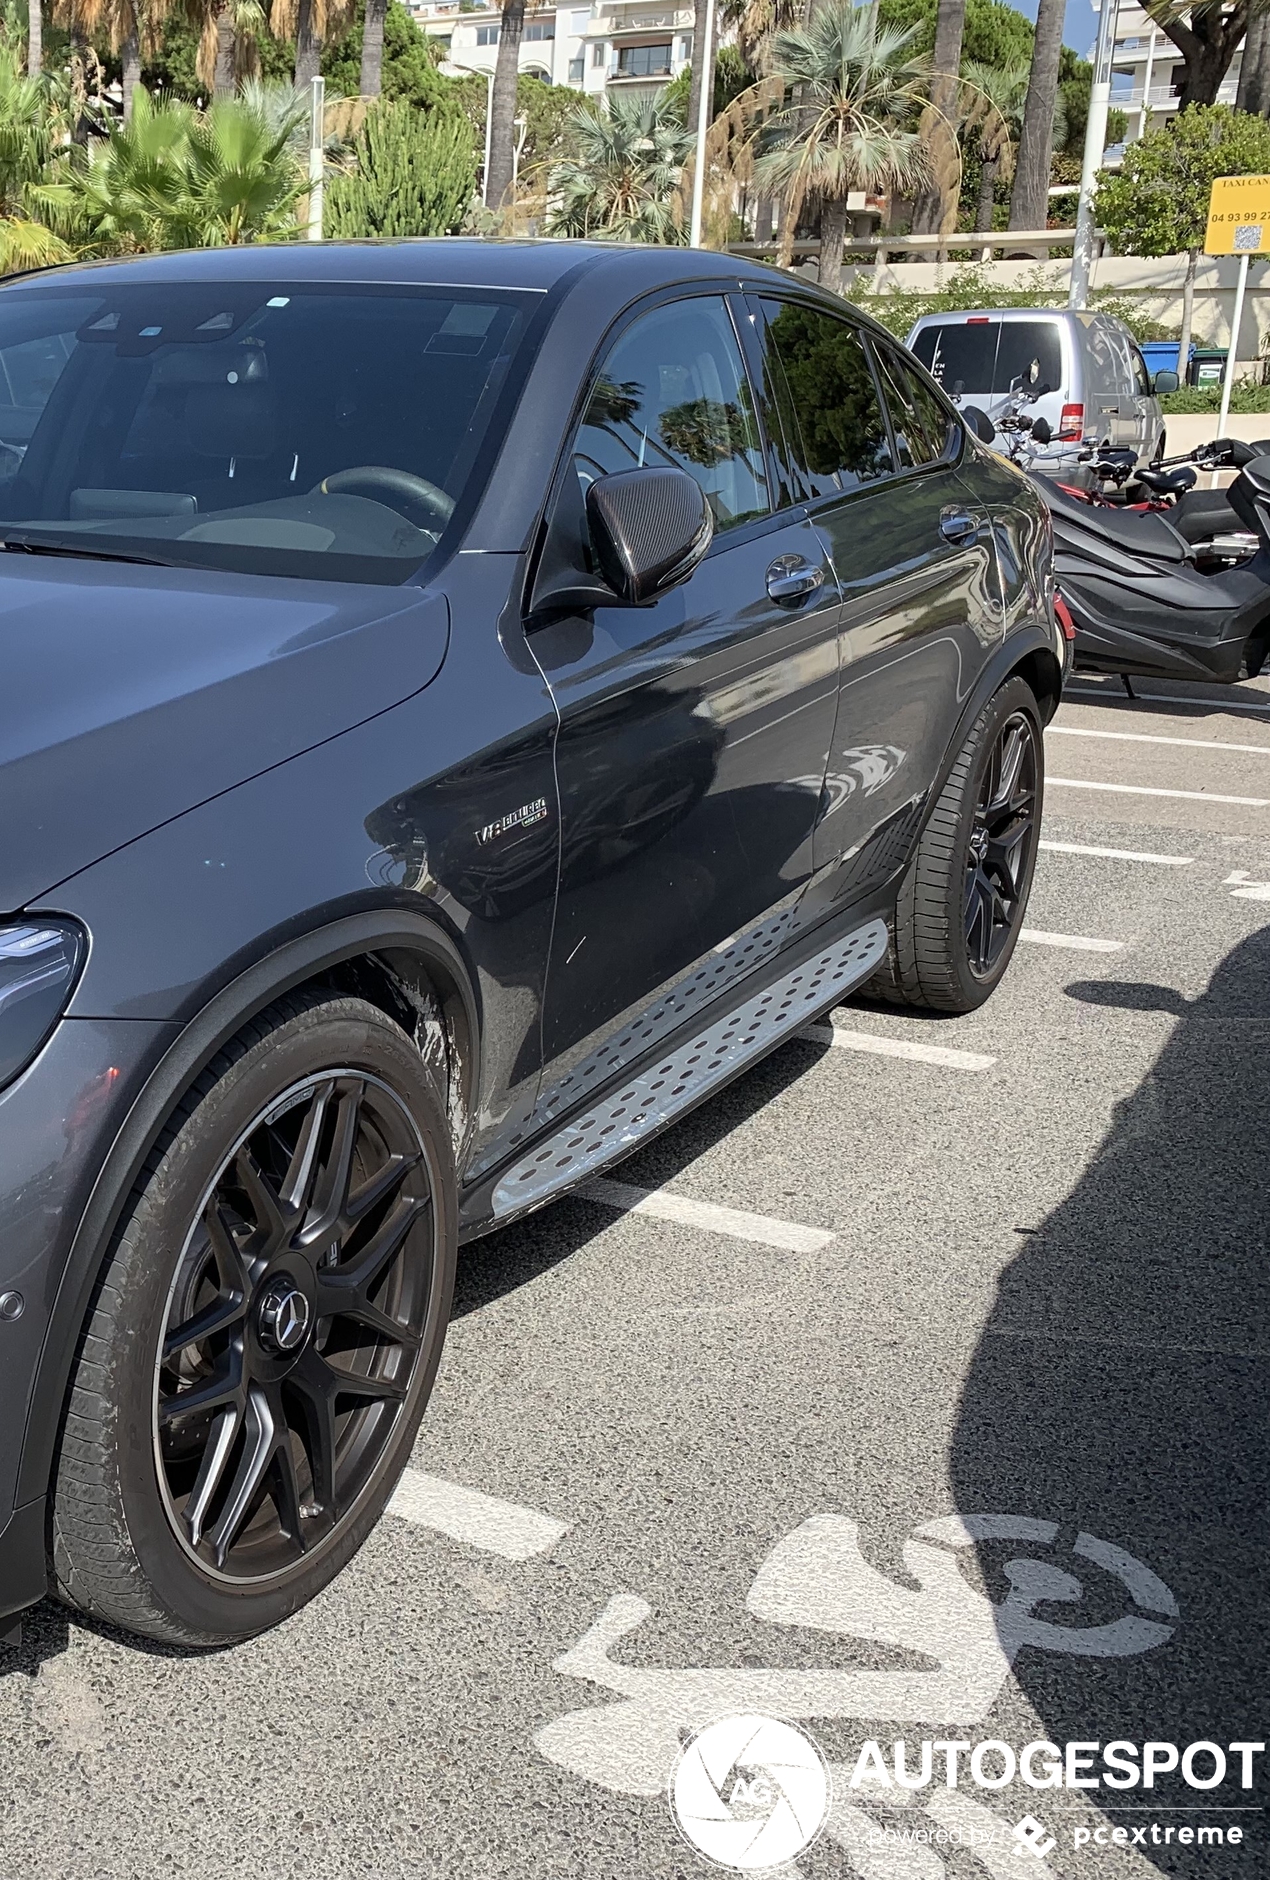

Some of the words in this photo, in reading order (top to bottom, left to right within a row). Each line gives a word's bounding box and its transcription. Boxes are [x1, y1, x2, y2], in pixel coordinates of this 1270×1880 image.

[1222, 179, 1245, 188] TAXI
[1212, 213, 1224, 223] 04
[1227, 212, 1241, 222] 93
[1244, 211, 1257, 221] 99
[473, 819, 503, 847] V8
